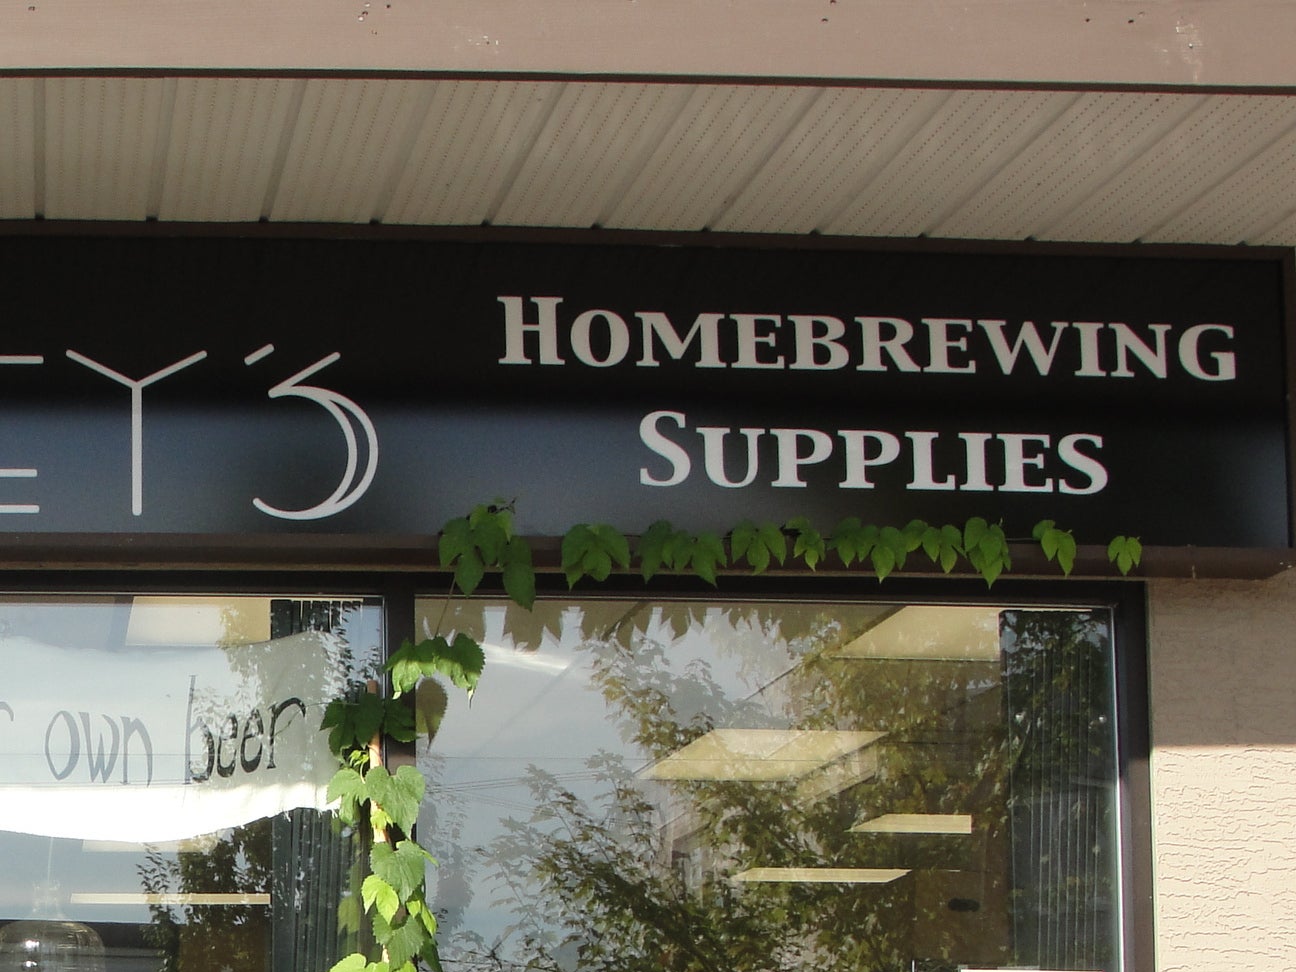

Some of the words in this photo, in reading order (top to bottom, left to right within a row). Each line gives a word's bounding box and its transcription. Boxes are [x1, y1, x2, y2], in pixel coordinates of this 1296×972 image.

[497, 294, 1238, 382] HOMEBREWING
[638, 410, 1109, 496] SUPPLIES
[44, 709, 153, 789] own
[183, 674, 307, 785] beer
